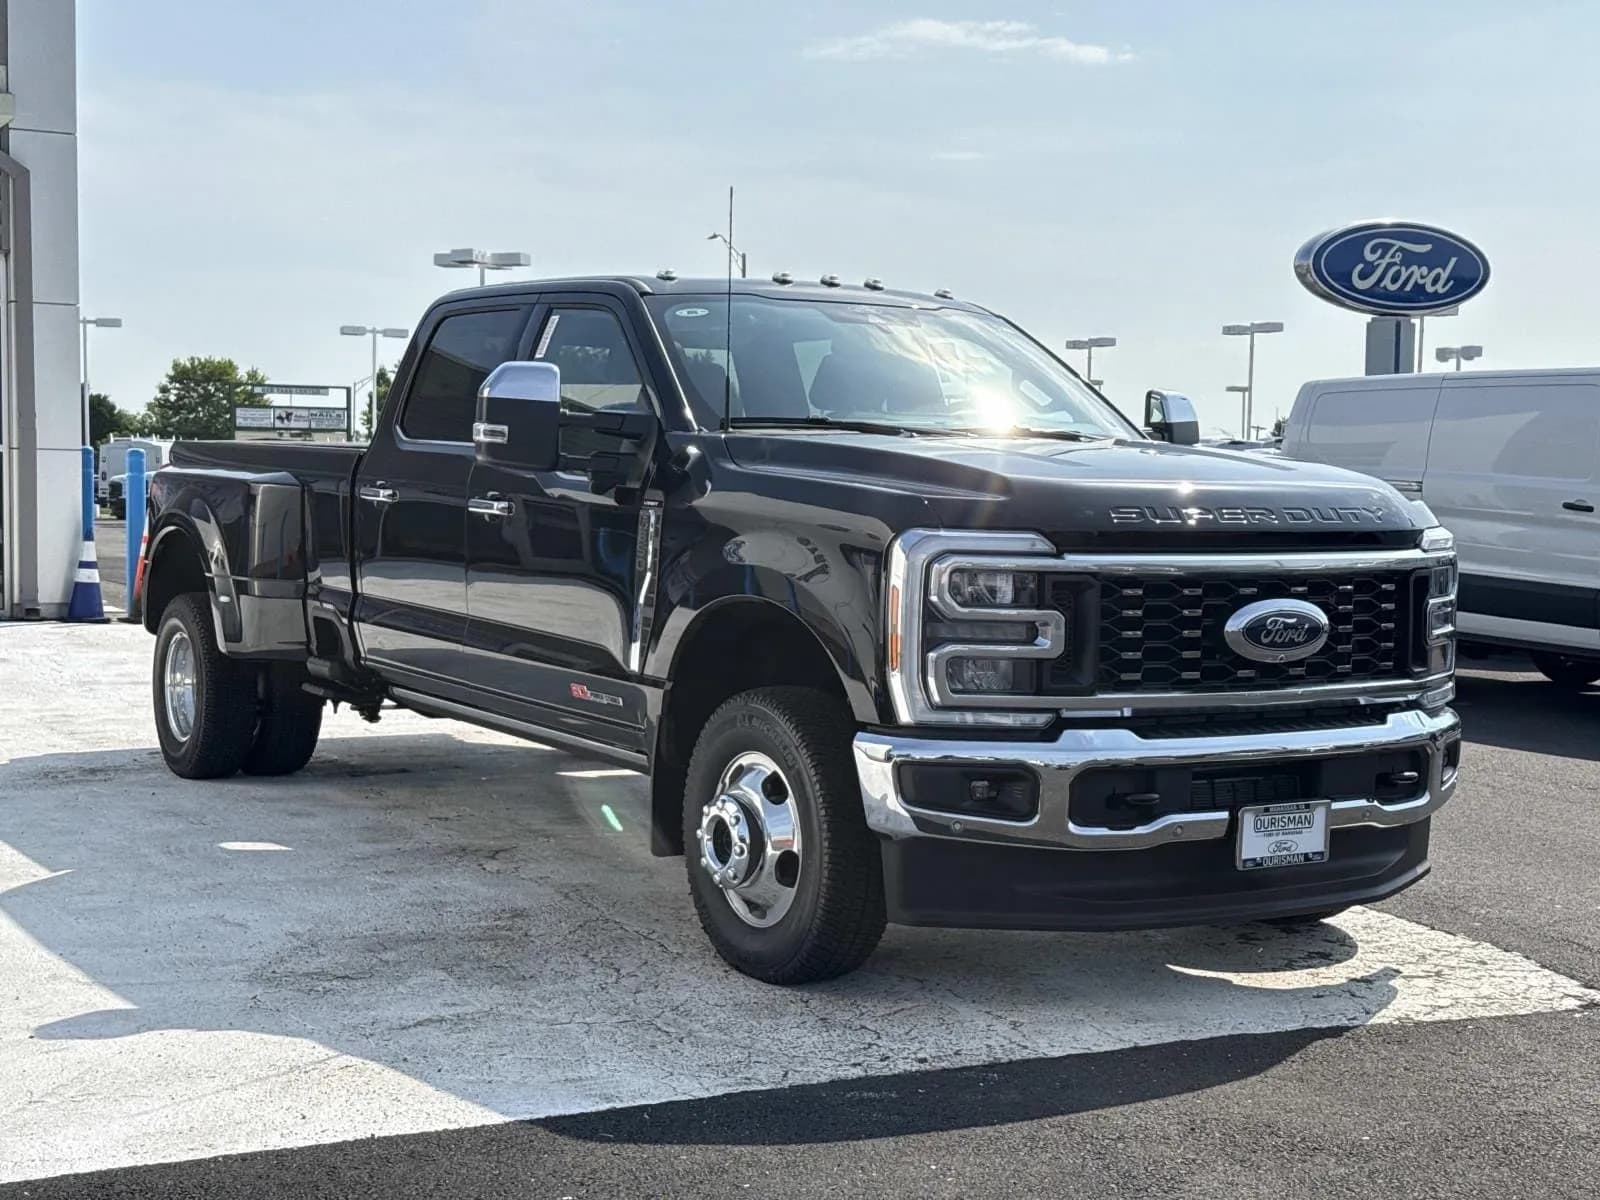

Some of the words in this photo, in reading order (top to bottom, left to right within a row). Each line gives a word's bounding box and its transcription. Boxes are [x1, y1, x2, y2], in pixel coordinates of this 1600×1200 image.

[1352, 238, 1458, 294] Ford
[1109, 506, 1279, 525] SUPER
[1283, 507, 1384, 524] DUTY
[1260, 617, 1309, 644] Ford
[1255, 815, 1311, 830] OURISMAN
[1272, 841, 1294, 853] Ford
[1263, 855, 1304, 866] OURISMAN
